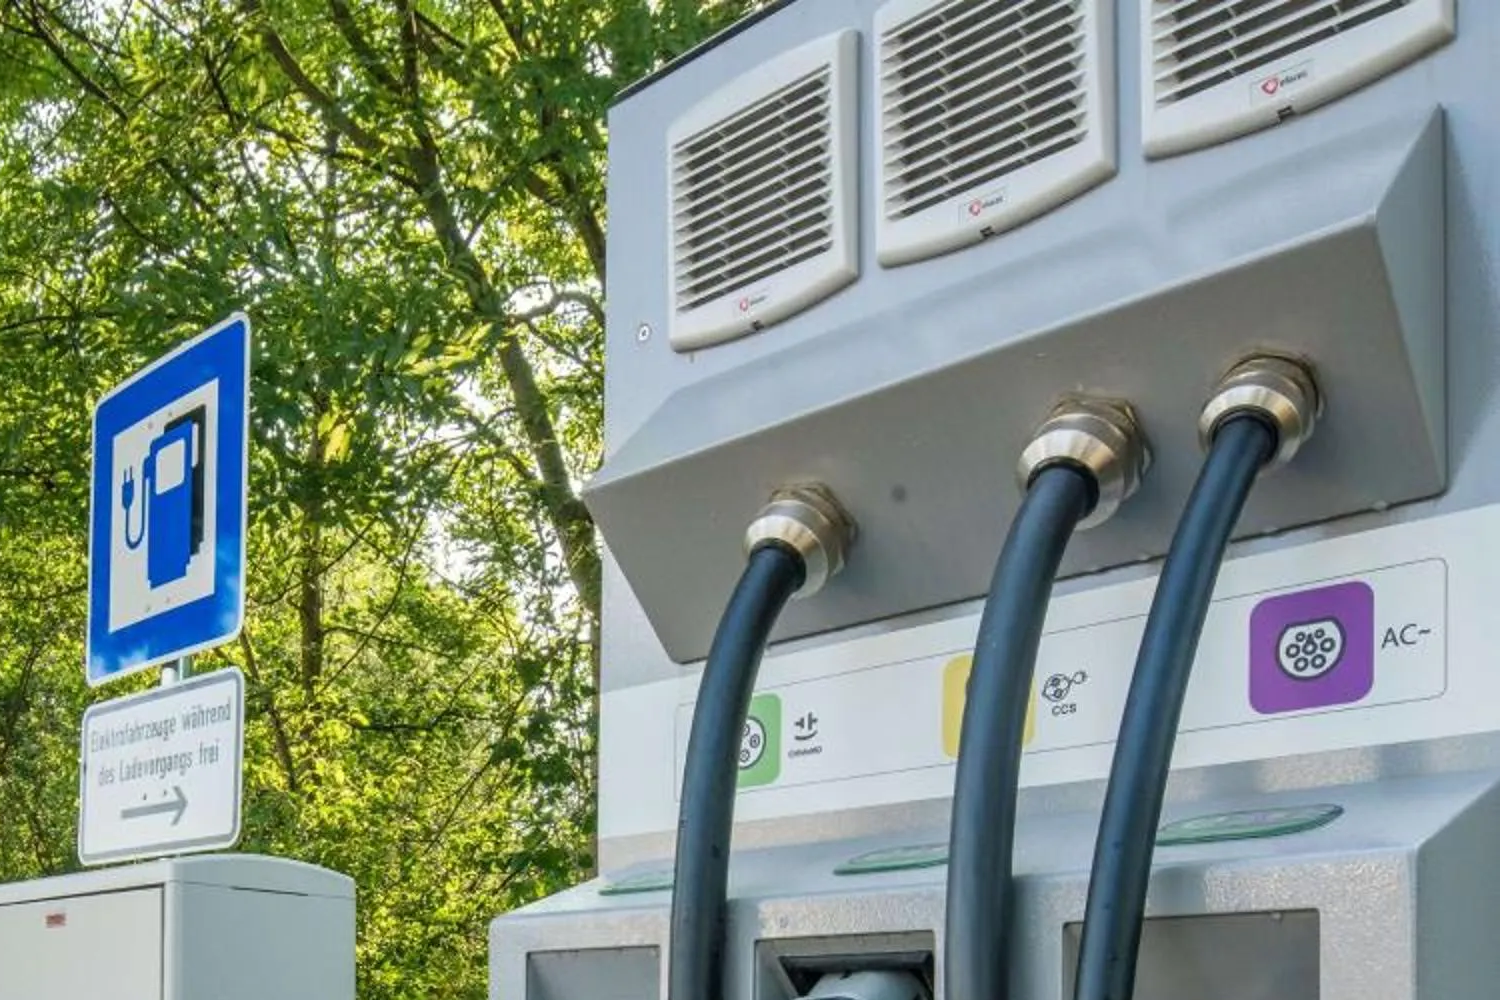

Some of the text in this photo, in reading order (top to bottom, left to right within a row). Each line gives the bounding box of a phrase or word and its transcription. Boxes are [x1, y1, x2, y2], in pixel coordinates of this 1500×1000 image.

[182, 697, 231, 731] während
[1051, 703, 1077, 717] CCS
[99, 738, 220, 786] des Ladevorgangs frei
